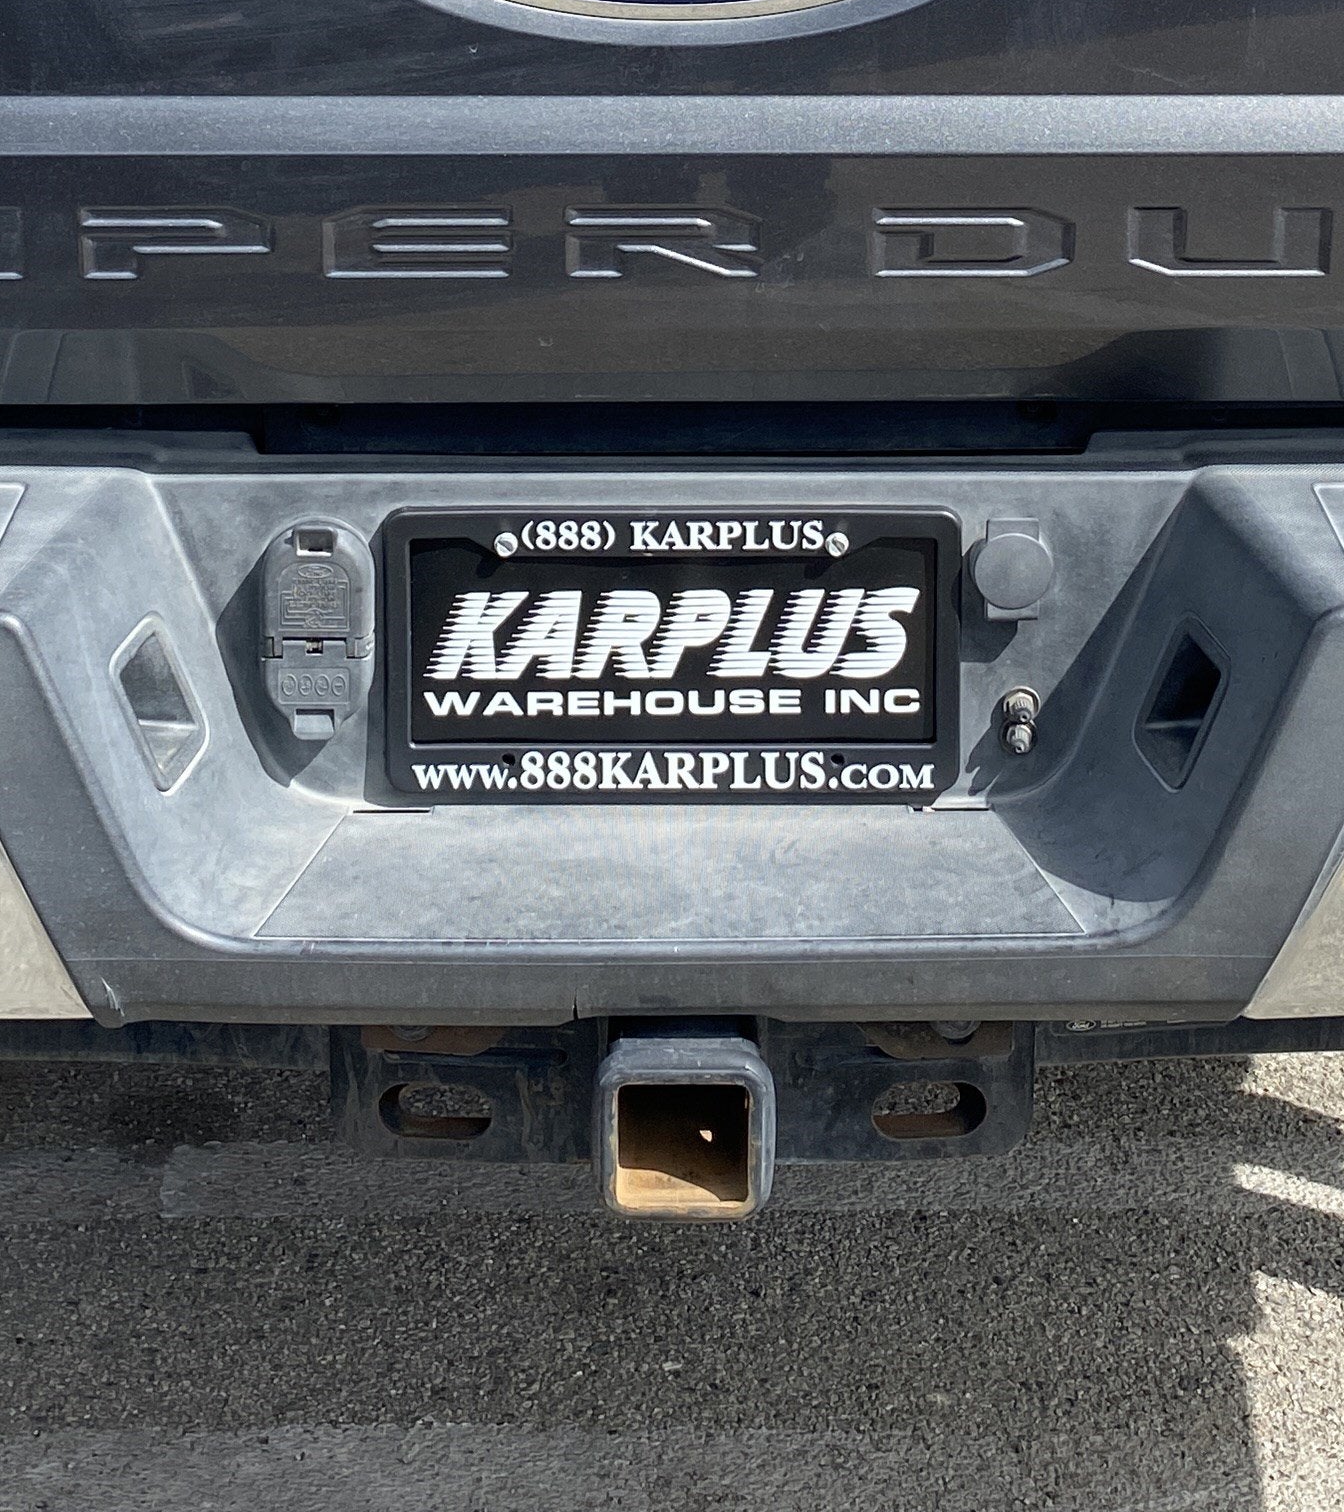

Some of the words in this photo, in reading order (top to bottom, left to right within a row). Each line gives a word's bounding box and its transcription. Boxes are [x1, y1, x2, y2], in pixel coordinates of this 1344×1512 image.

[521, 520, 616, 552] (888)
[629, 520, 824, 552] KARPLUS
[423, 586, 920, 679] KARPLUS
[423, 687, 802, 717] WAREHOUSE
[823, 687, 921, 715] INC
